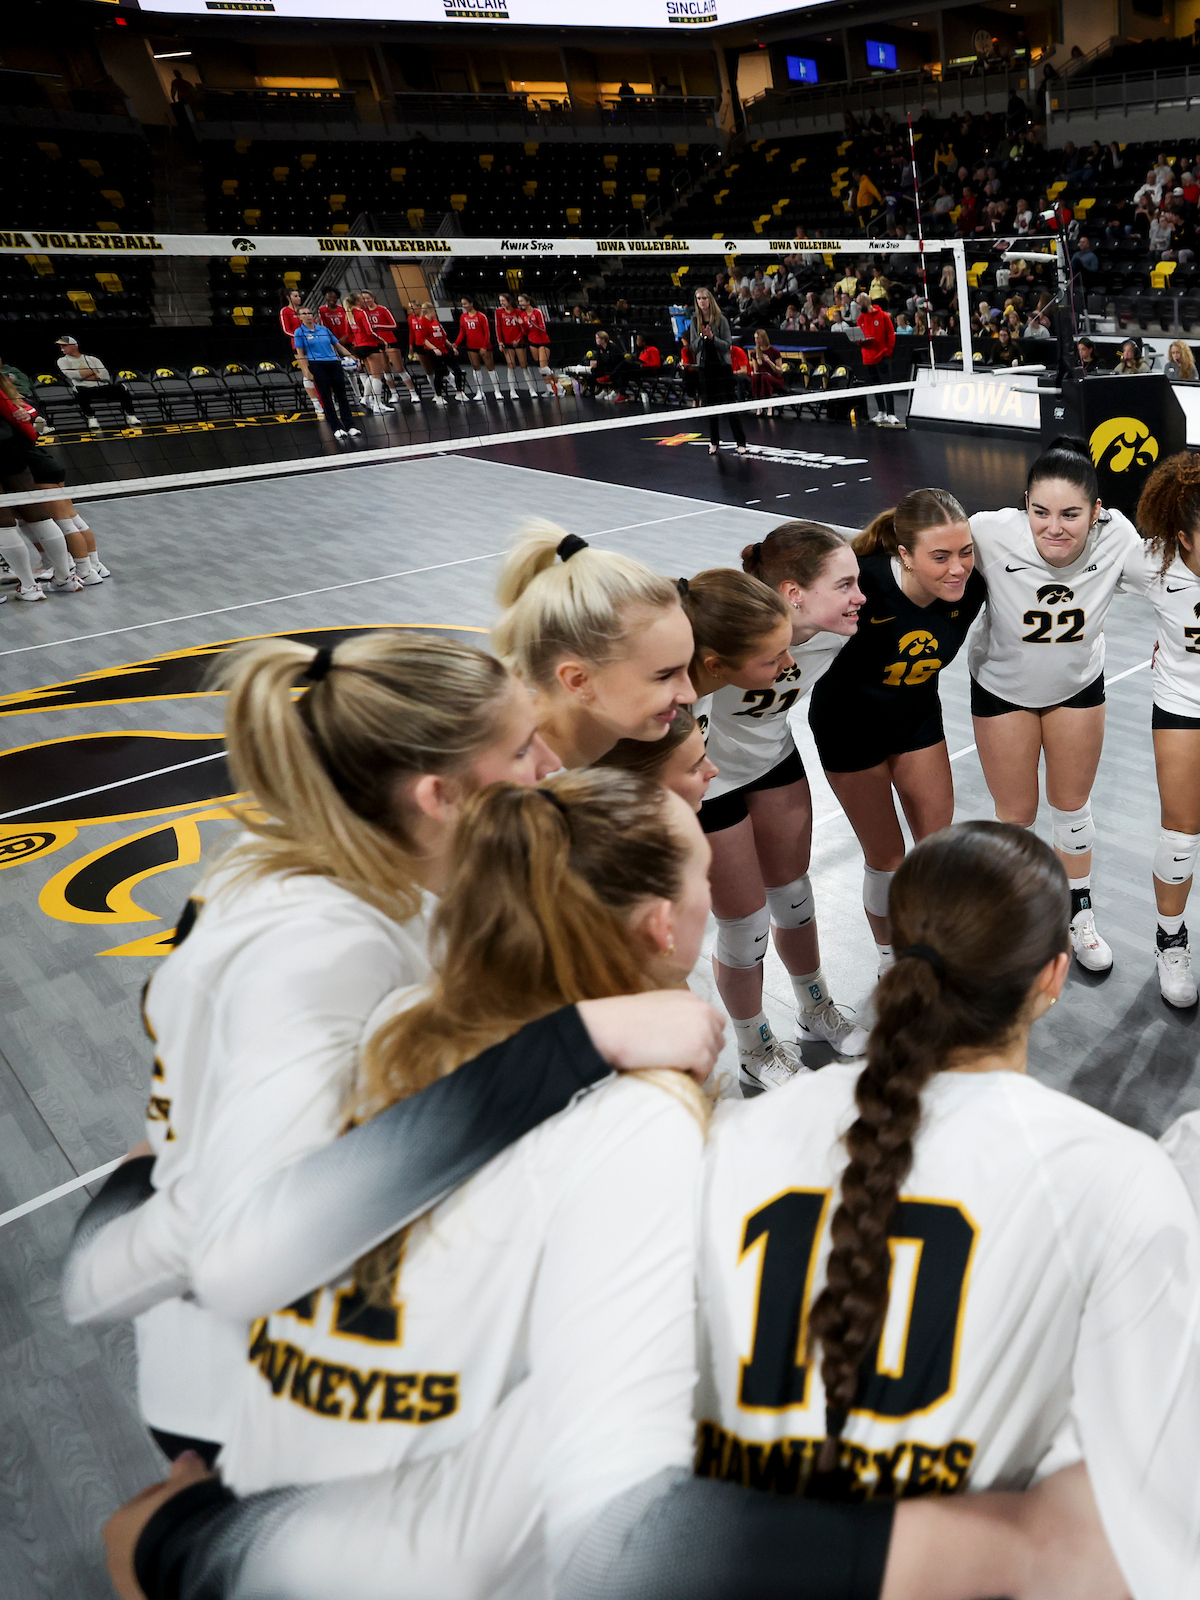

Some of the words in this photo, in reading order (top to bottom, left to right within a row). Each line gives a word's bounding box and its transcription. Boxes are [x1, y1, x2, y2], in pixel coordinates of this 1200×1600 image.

[665, 0, 718, 15] SINCLAIR
[31, 233, 164, 251] VOLLEYBALL
[317, 238, 362, 252] IOWA
[362, 239, 452, 252] VOLLEYBALL
[596, 241, 627, 251] IOWA
[627, 240, 690, 251] VOLLEYBALL
[769, 241, 792, 250] IOWA
[793, 240, 842, 250] VOLLEYBALL
[940, 379, 1025, 420] IOWA
[1021, 607, 1085, 644] 22
[882, 658, 943, 687] 16
[731, 687, 801, 719] 21
[736, 1186, 982, 1424] 10
